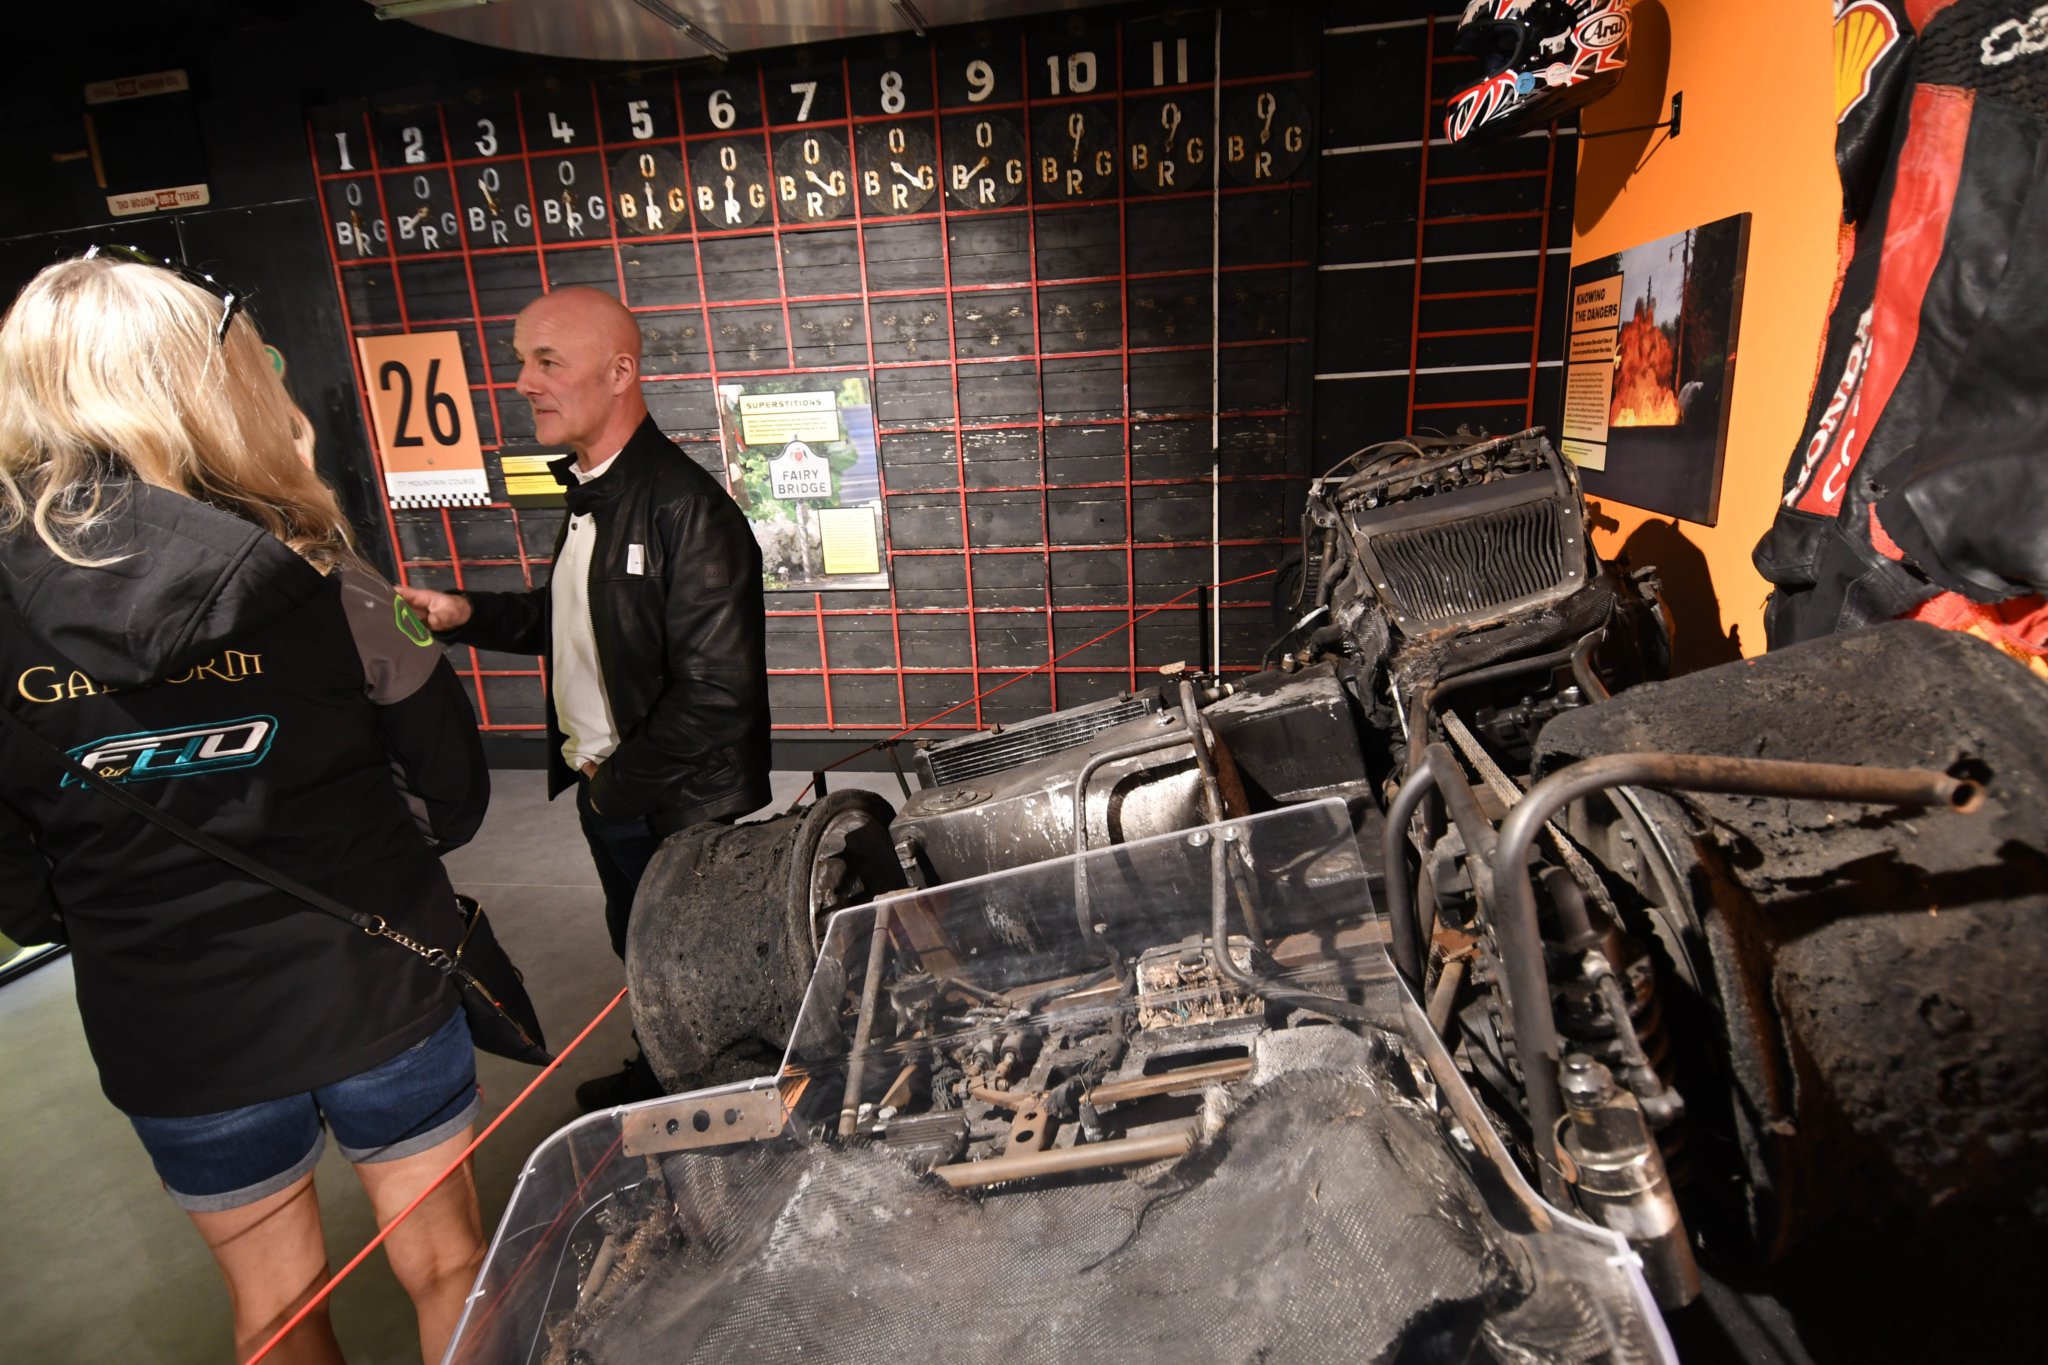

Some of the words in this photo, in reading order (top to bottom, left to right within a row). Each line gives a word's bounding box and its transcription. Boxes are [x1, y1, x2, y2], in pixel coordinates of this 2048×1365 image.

[1585, 19, 1622, 42] Arai
[966, 60, 994, 102] 9
[1047, 52, 1096, 95] 10
[1152, 38, 1188, 86] 11
[708, 90, 736, 129] 6
[790, 82, 816, 122] 7
[880, 70, 905, 114] 8
[475, 119, 497, 156] 3
[548, 112, 574, 143] 4
[628, 100, 653, 139] 5
[335, 133, 354, 170] 1
[402, 127, 426, 164] 2
[1132, 144, 1148, 170] B
[1158, 161, 1174, 187] R
[1187, 138, 1203, 163] G
[1228, 136, 1244, 161] B
[1256, 152, 1271, 178] R
[1285, 127, 1301, 152] G
[864, 171, 880, 196] B
[892, 184, 908, 208] R
[918, 165, 934, 190] G
[952, 165, 969, 190] B
[980, 179, 996, 203] R
[1006, 160, 1022, 184] G
[1042, 157, 1058, 183] B
[1067, 169, 1083, 195] R
[1096, 151, 1112, 176] G
[544, 200, 561, 223] B
[588, 196, 605, 220] G
[620, 193, 637, 218] B
[646, 206, 664, 230] R
[668, 188, 684, 212] G
[698, 186, 714, 211] B
[724, 200, 741, 224] R
[749, 184, 766, 208] G
[780, 176, 796, 201] B
[807, 192, 823, 217] R
[830, 171, 846, 196] G
[336, 222, 353, 245] B
[373, 219, 388, 241] G
[422, 226, 440, 250] R
[441, 212, 457, 235] G
[469, 207, 486, 231] B
[492, 220, 509, 244] R
[514, 204, 531, 227] G
[1575, 310, 1586, 323] THE
[1587, 304, 1618, 320] DANGERS
[1576, 288, 1605, 305] KNOWING
[379, 358, 461, 447] 26
[746, 399, 822, 409] SUPERSTITIONS
[778, 482, 826, 494] BRIDGE
[783, 470, 818, 480] FAIRY
